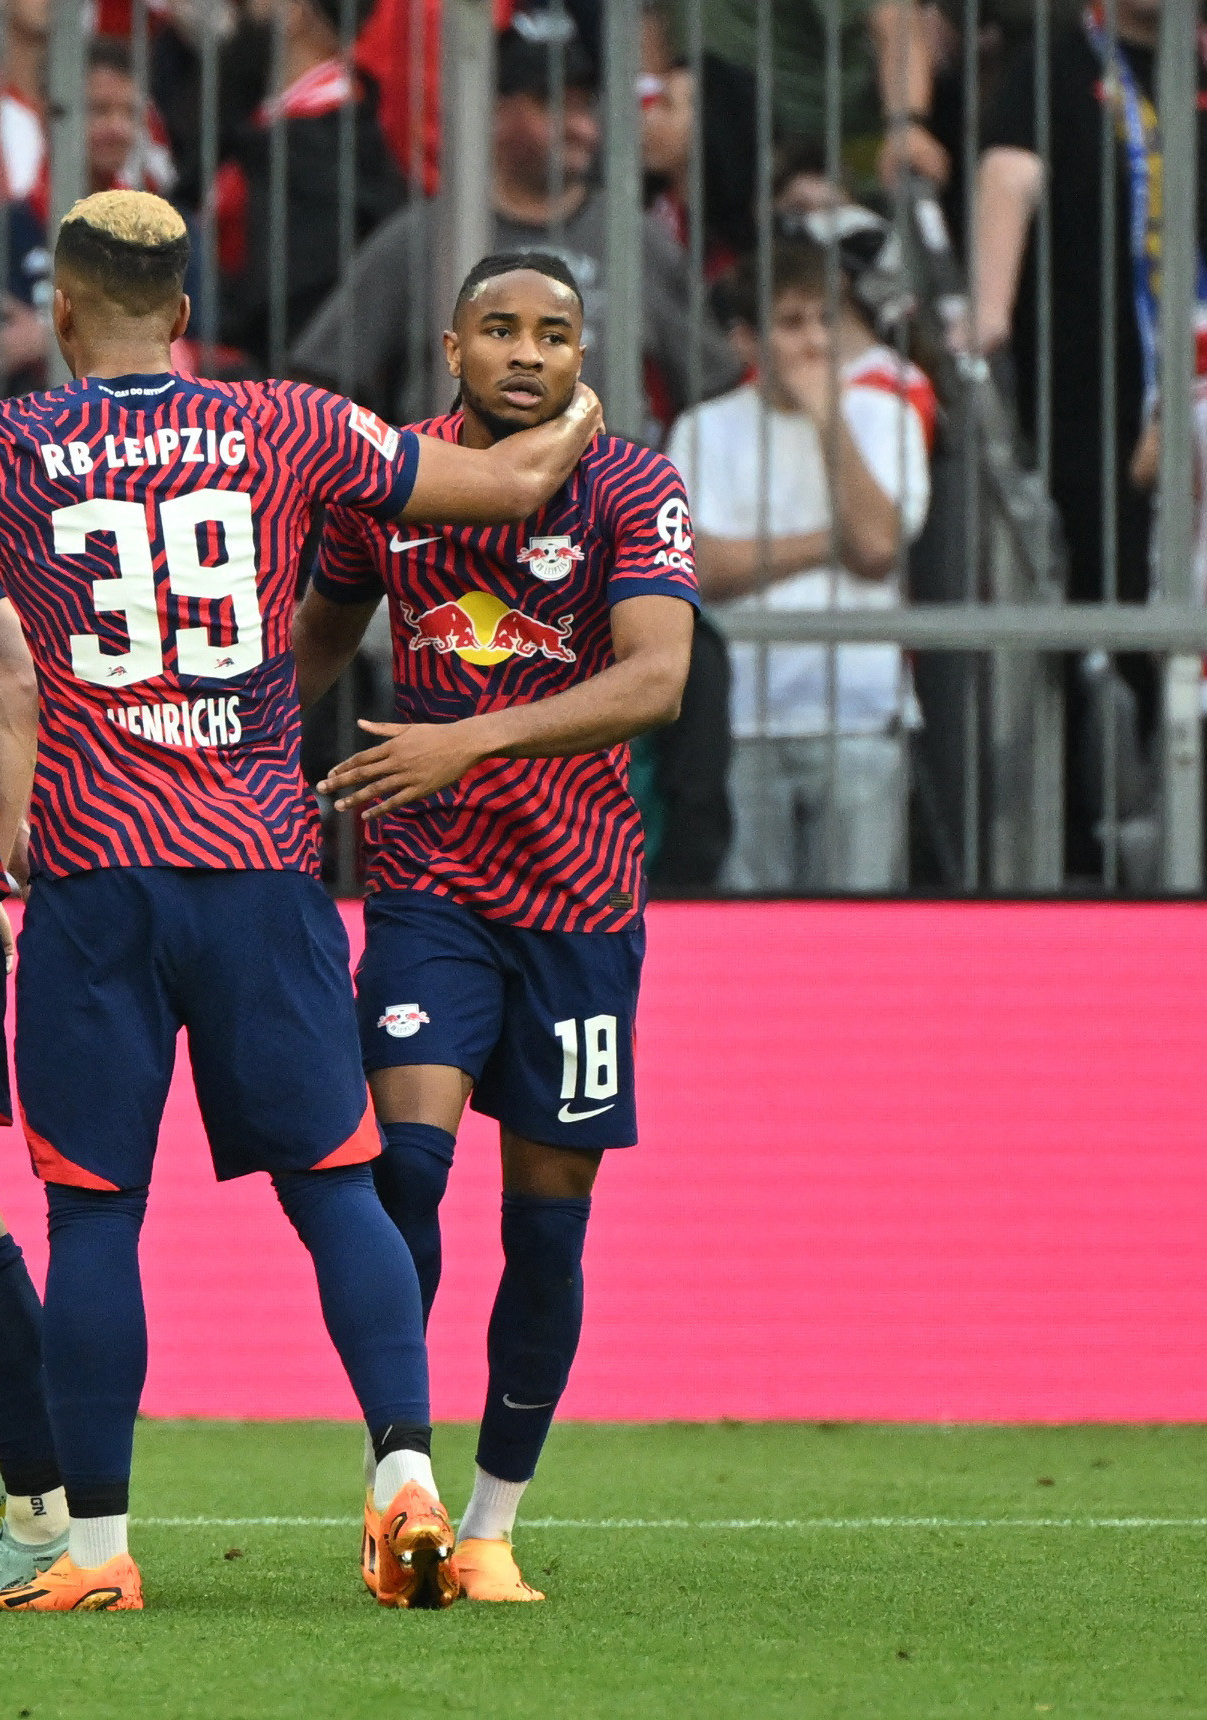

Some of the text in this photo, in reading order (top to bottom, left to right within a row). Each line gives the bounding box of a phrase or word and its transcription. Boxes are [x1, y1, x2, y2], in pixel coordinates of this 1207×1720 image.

[40, 427, 246, 480] RB LEIPZIG
[51, 488, 264, 688] 39
[653, 550, 694, 573] ACC
[554, 1014, 618, 1100] 18
